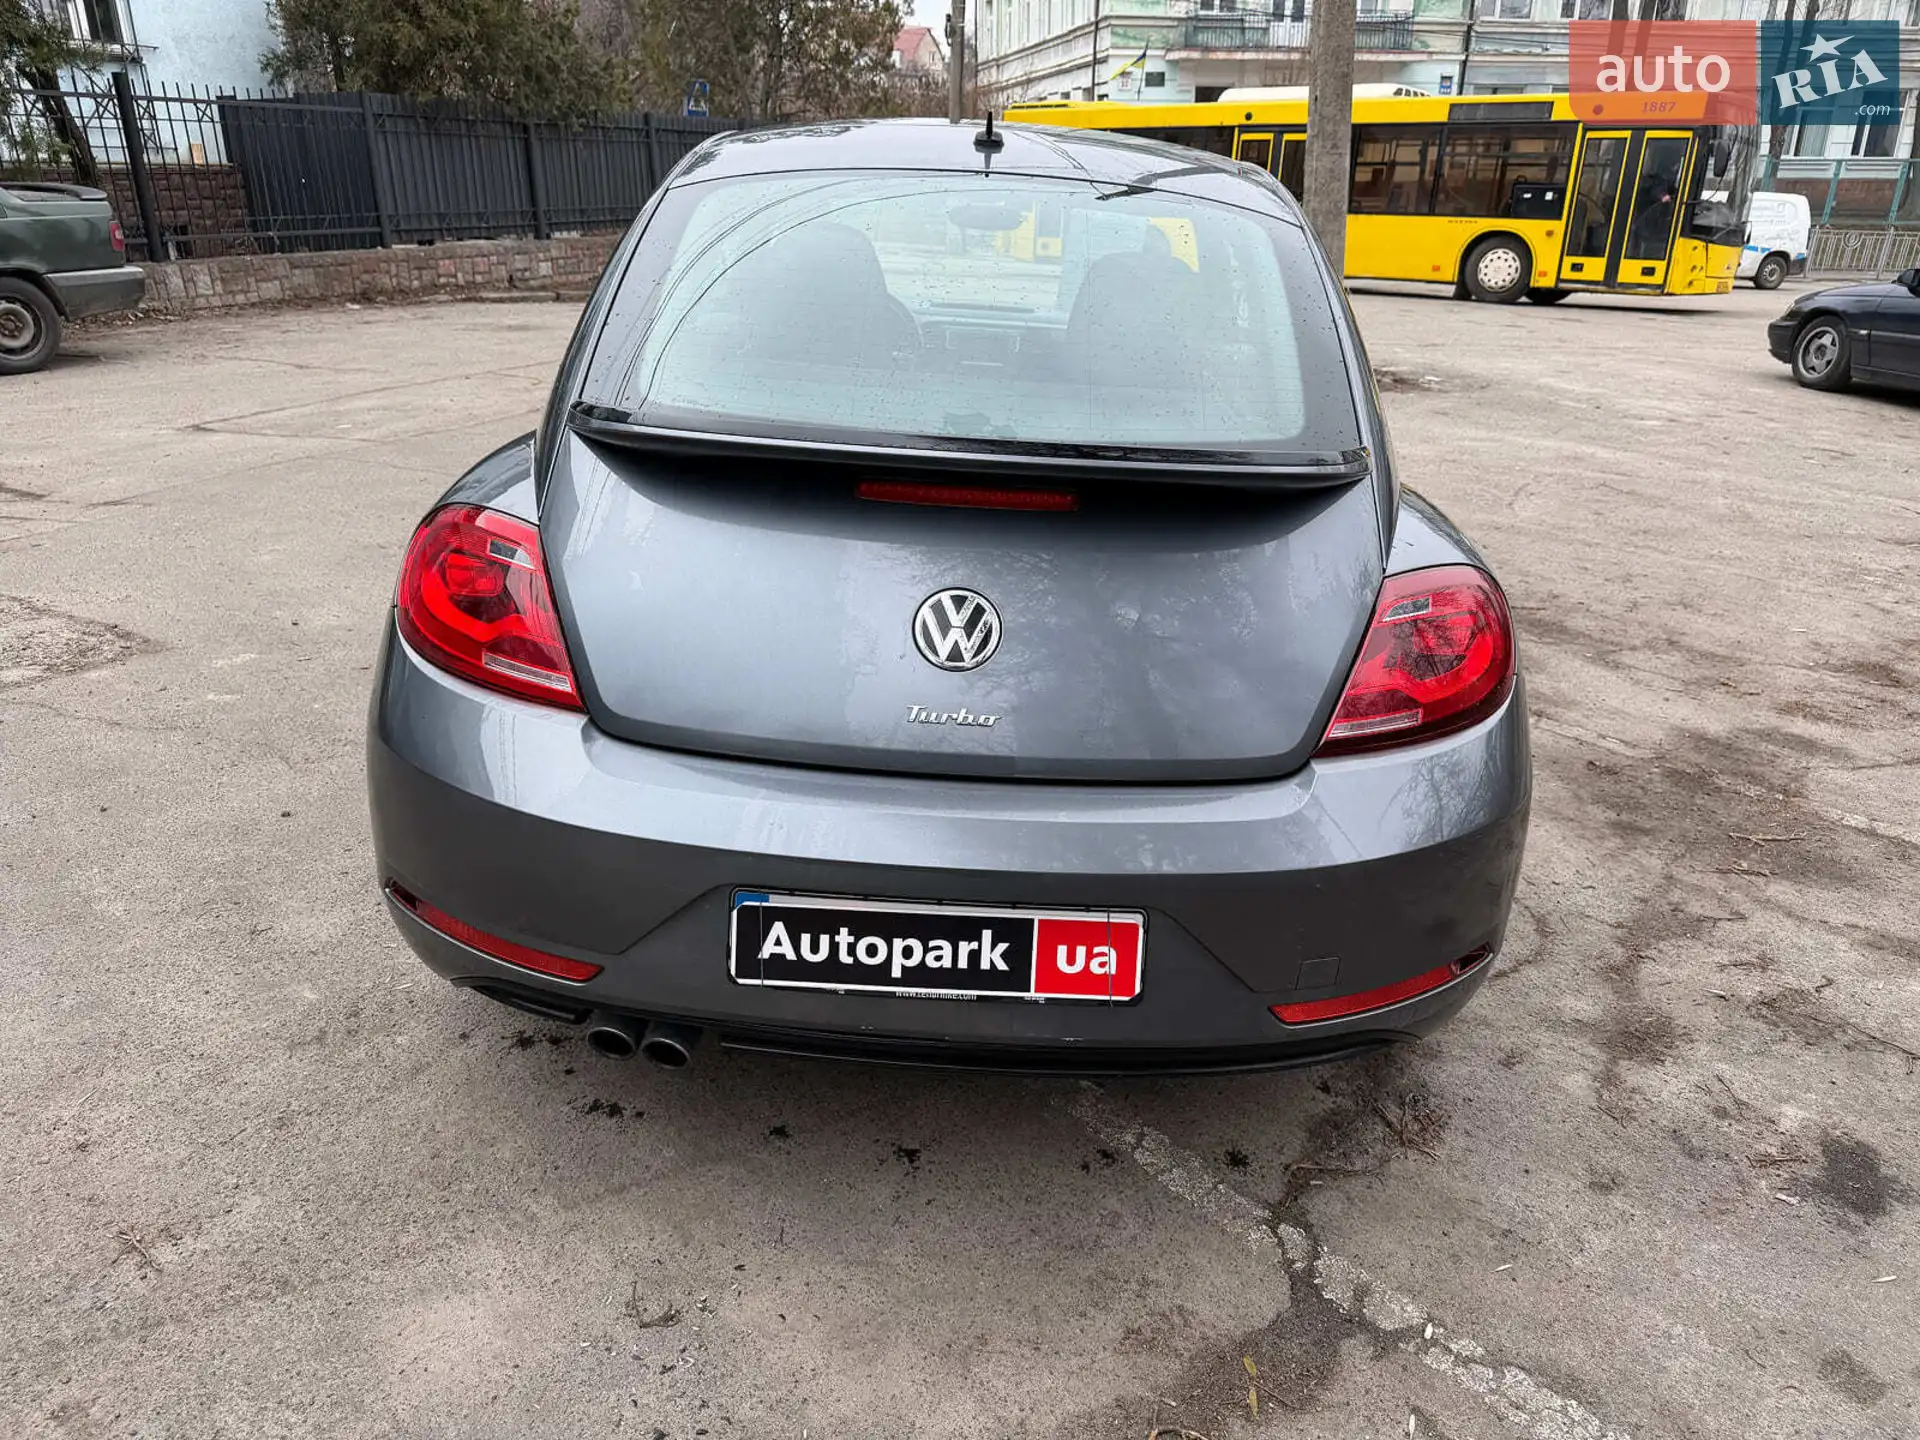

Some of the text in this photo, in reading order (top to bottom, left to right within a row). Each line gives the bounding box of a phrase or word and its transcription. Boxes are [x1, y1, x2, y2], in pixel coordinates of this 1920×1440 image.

[1641, 101, 1675, 113] 1887
[906, 704, 1002, 727] Turbo
[756, 921, 1118, 978] Autopark ua
